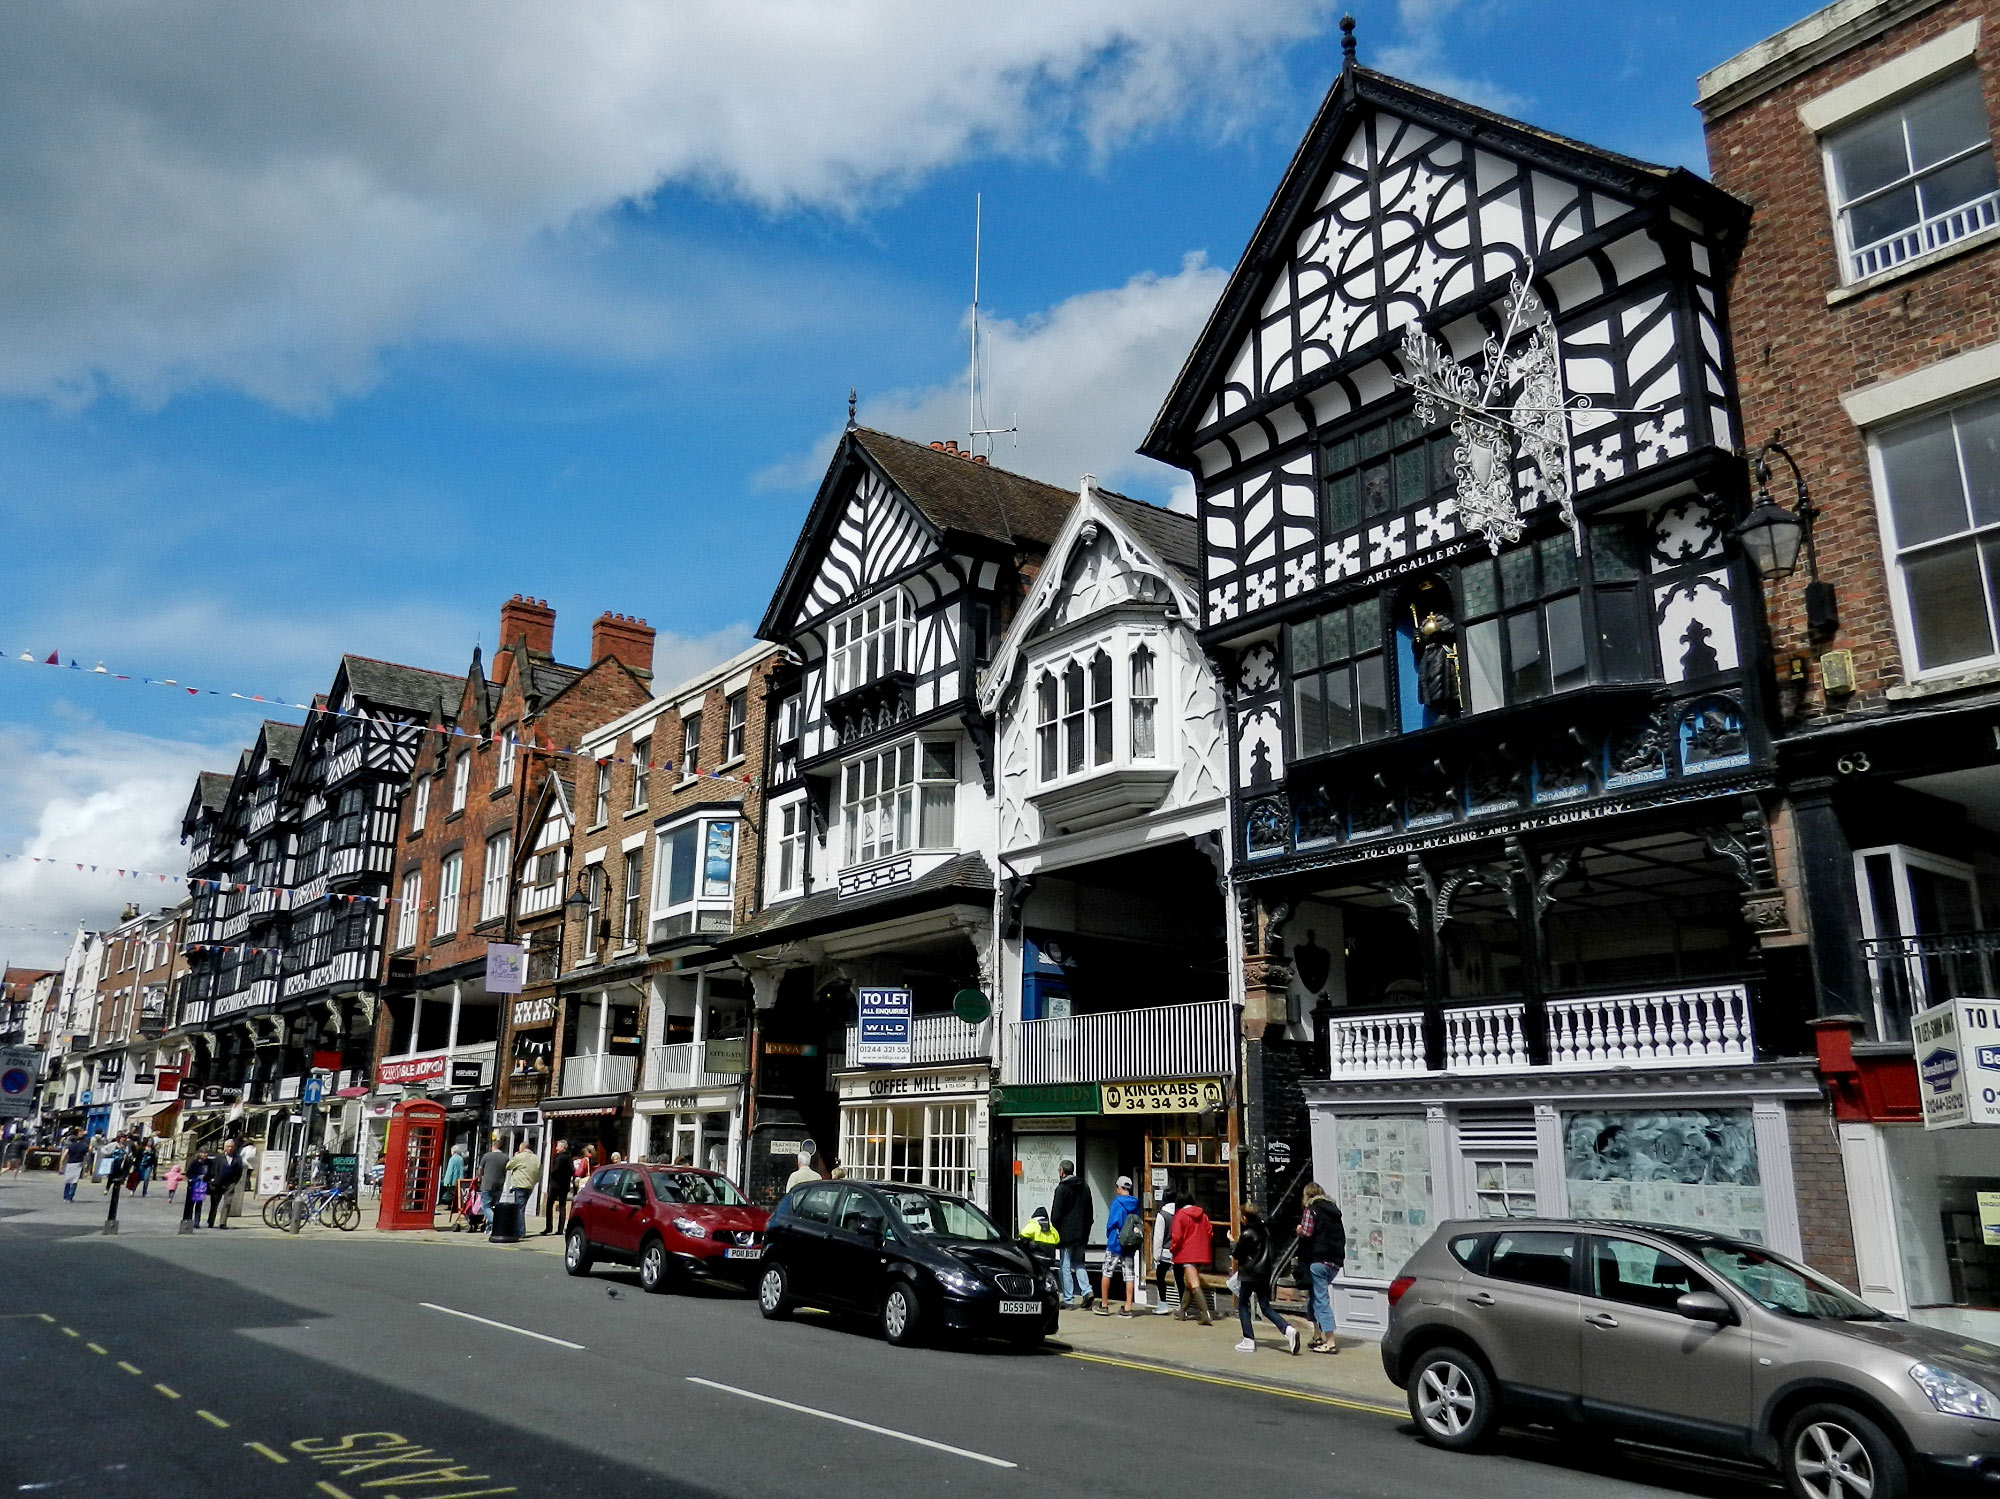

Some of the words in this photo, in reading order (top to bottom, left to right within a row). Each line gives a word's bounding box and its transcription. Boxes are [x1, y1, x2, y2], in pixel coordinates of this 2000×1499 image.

[1366, 568, 1392, 585] ART
[1398, 542, 1464, 574] GALLERY
[1837, 751, 1871, 775] 63
[1361, 848, 1379, 860] TO
[1387, 842, 1414, 855] GOD
[1423, 837, 1441, 849] MY
[1447, 830, 1478, 845] KING
[1488, 825, 1509, 836] AND
[1520, 819, 1539, 831] MY
[1547, 803, 1624, 826] COUNTRY
[862, 993, 882, 1006] TO
[884, 993, 909, 1005] LET
[875, 1007, 909, 1016] ENQUIRIES
[1964, 1008, 1988, 1029] TO
[865, 1024, 905, 1032] WILD
[769, 1043, 799, 1053] DEVA
[860, 1045, 881, 1053] 01244
[6, 1059, 33, 1067] ZONE
[868, 1077, 908, 1095] COFFEE
[913, 1076, 941, 1092] MILL
[1123, 1082, 1199, 1097] KINGKABS
[1125, 1098, 1145, 1109] 34
[1151, 1097, 1171, 1109] 34
[1177, 1096, 1199, 1108] 34
[1003, 1302, 1024, 1313] DG59
